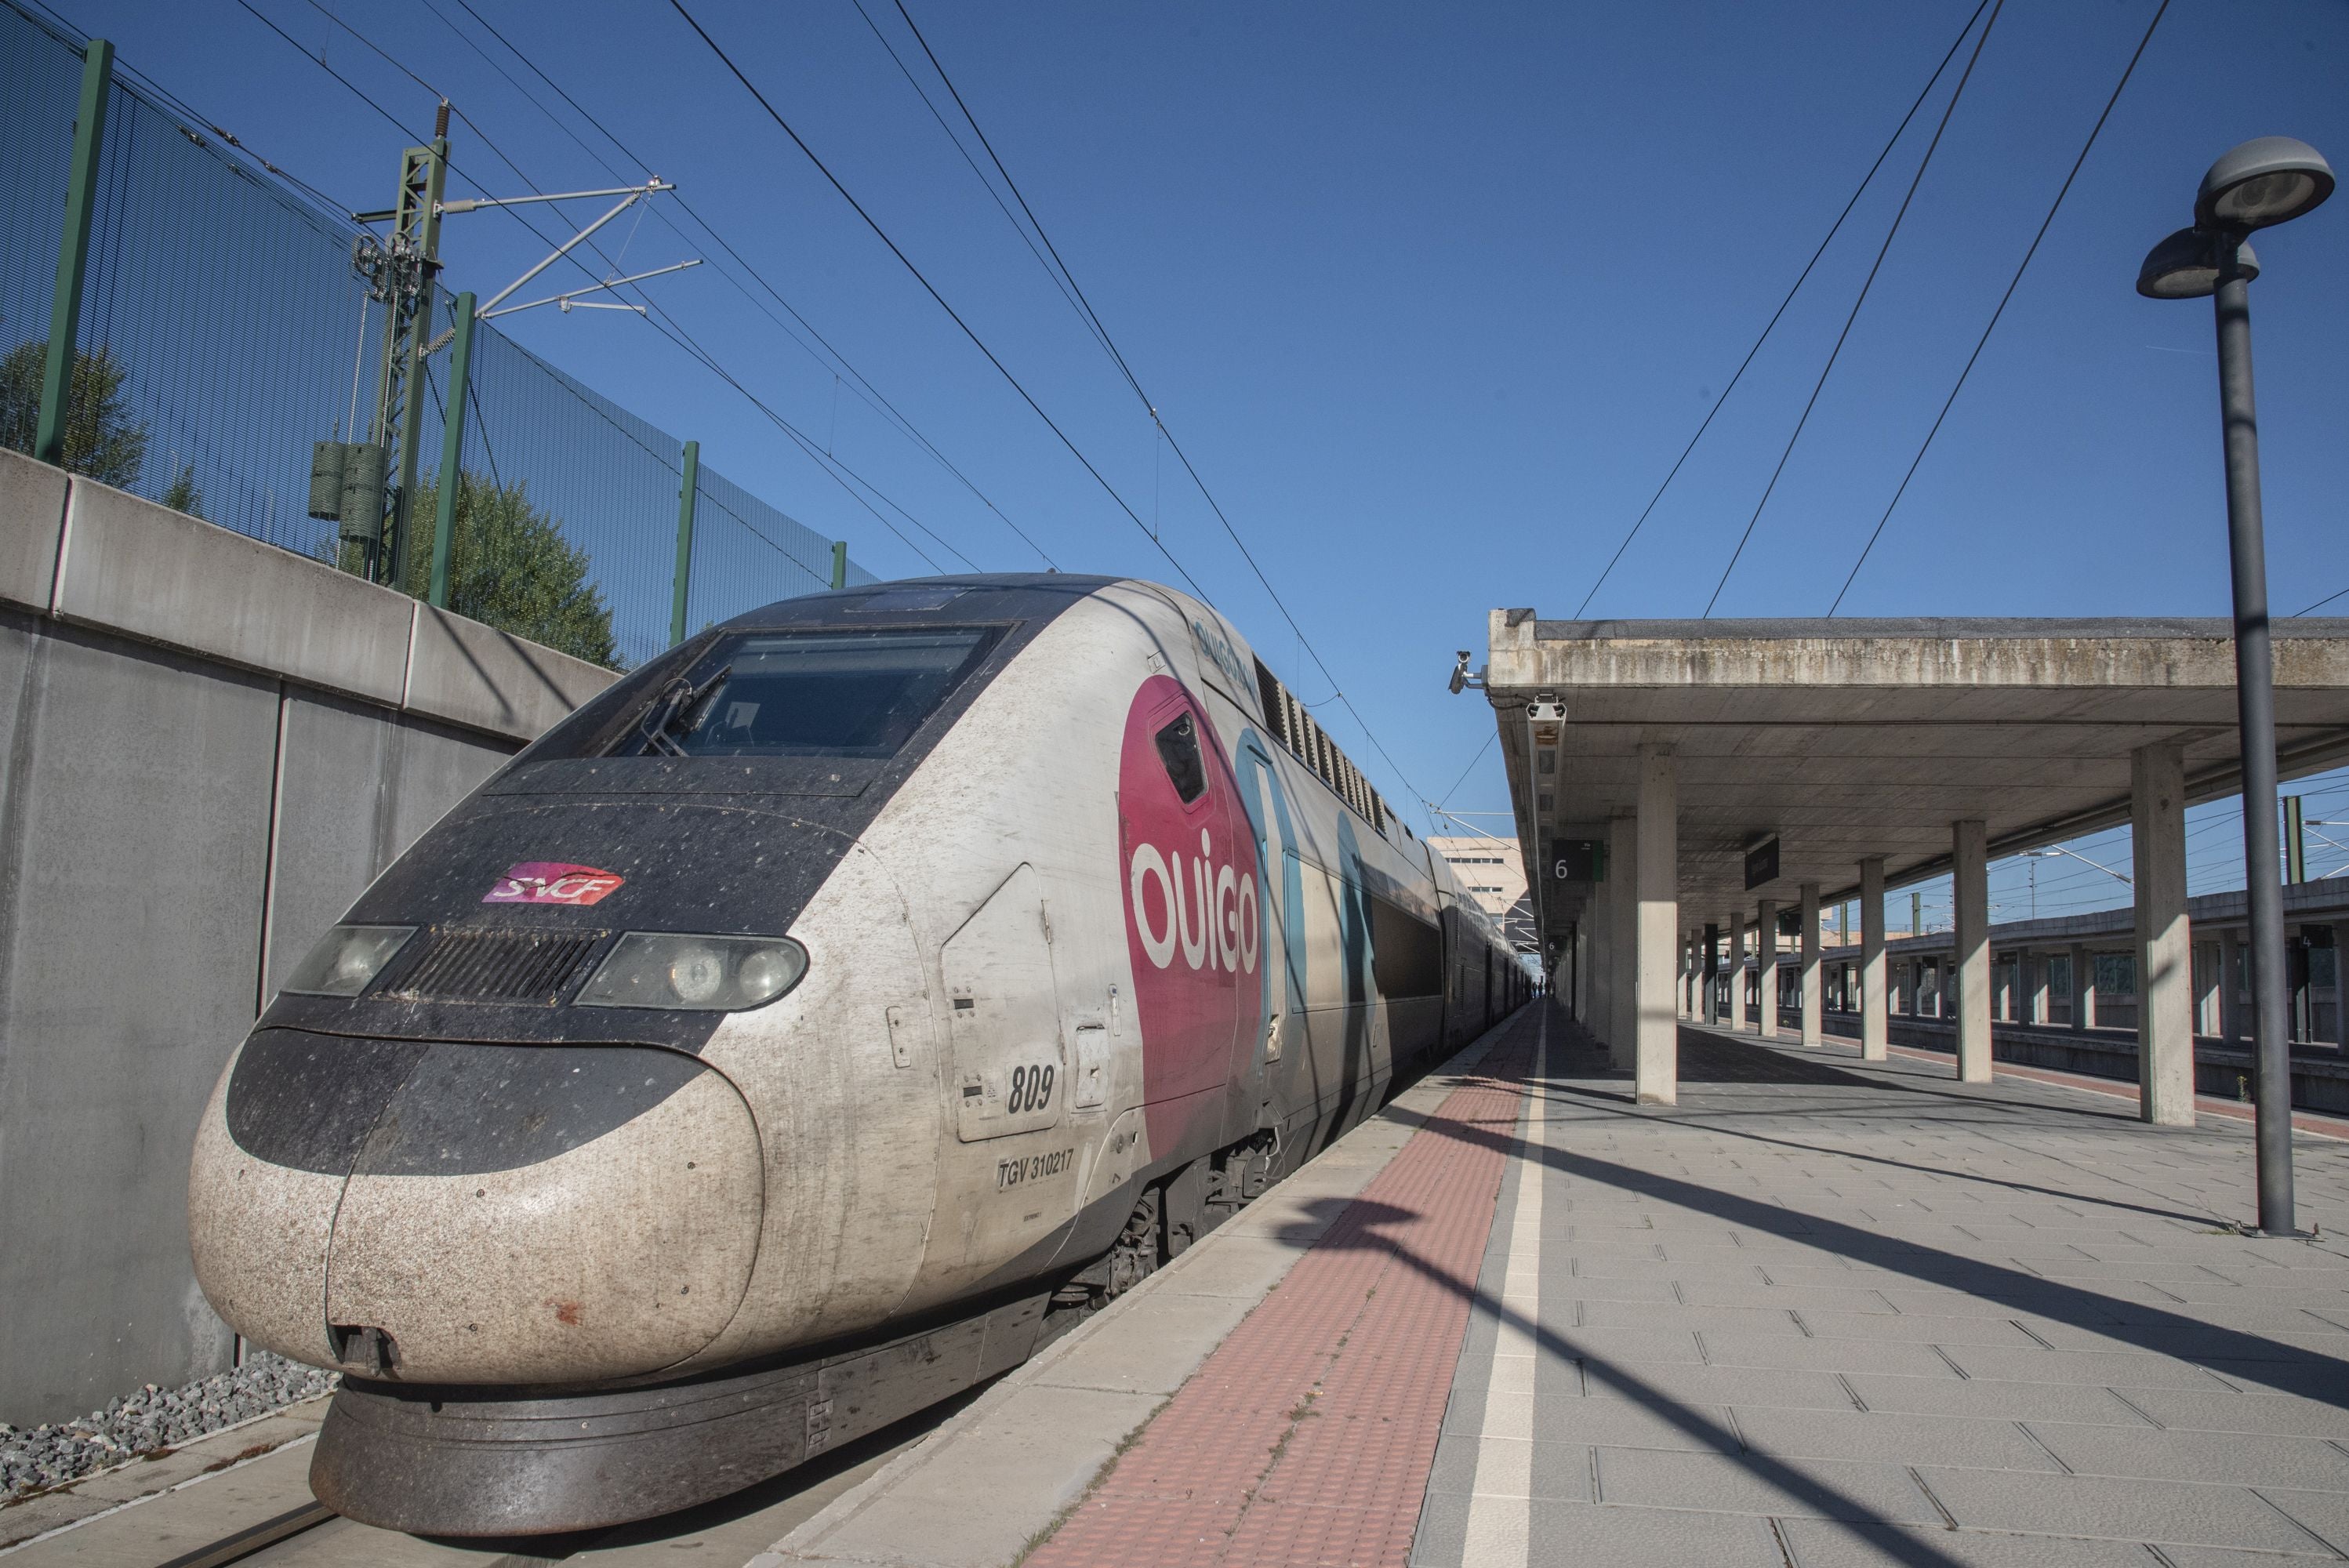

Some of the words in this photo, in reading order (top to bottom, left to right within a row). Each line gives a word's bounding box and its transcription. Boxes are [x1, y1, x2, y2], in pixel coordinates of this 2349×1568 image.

[1555, 859, 1568, 879] 6
[493, 877, 615, 898] SNCF
[1548, 942, 1555, 950] 6
[2303, 935, 2312, 948] 4
[1008, 1065, 1055, 1114] 809
[1000, 1157, 1029, 1188] TGV
[1031, 1148, 1074, 1180] 310217
